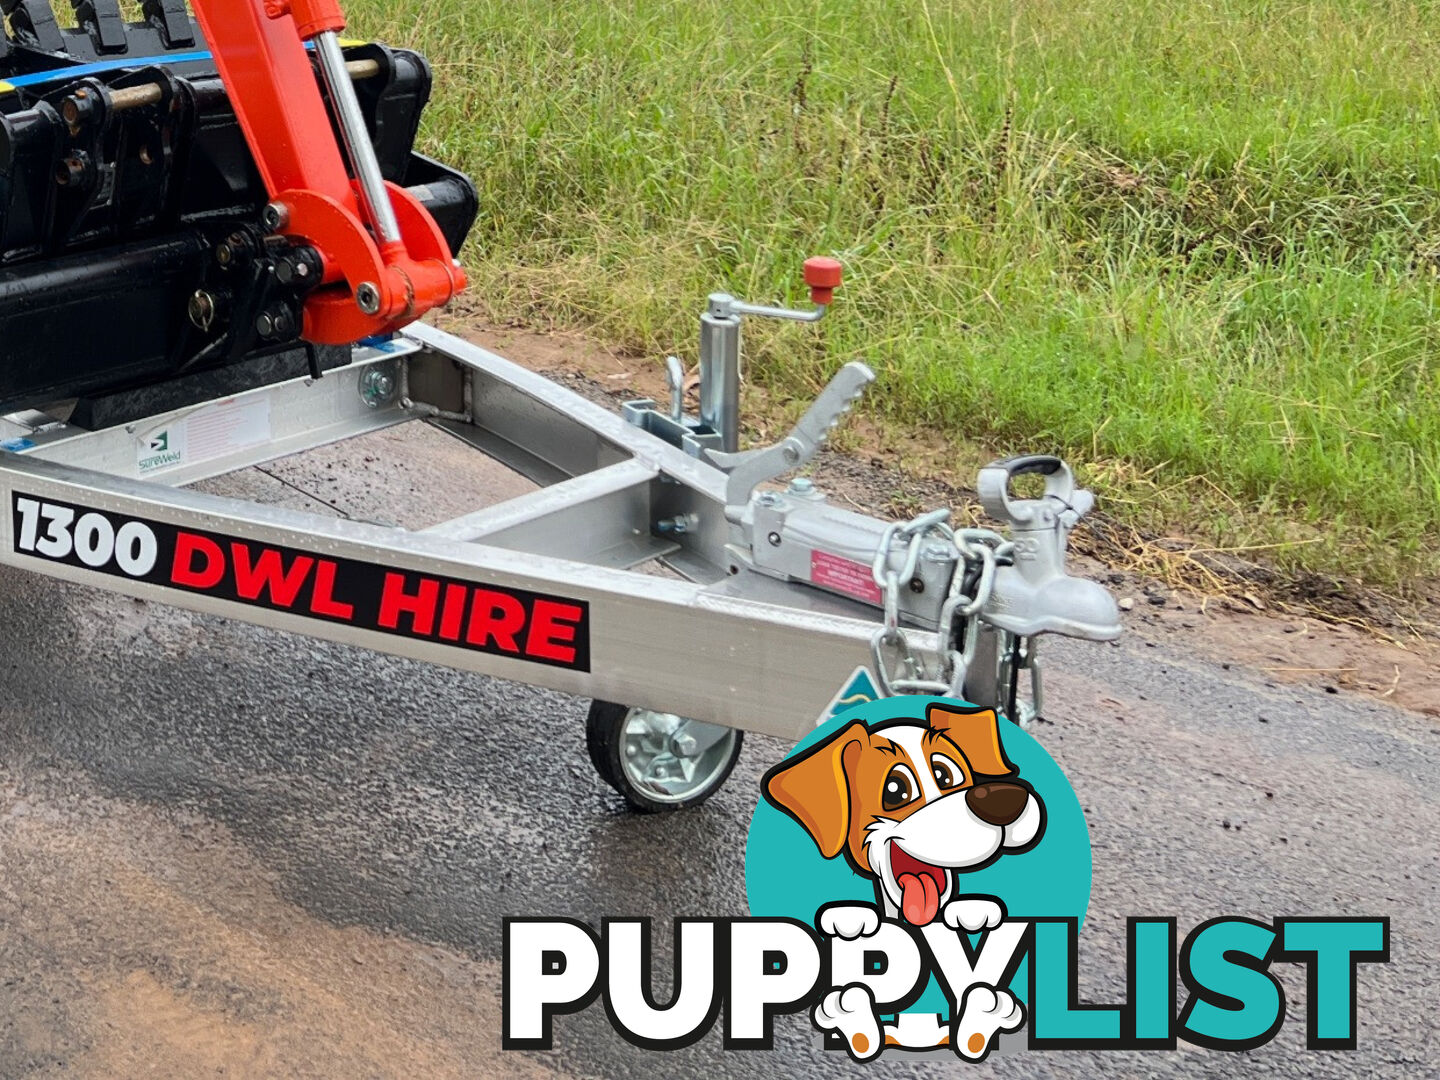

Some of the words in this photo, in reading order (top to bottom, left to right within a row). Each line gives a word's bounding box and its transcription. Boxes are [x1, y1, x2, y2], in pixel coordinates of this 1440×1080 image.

[16, 497, 158, 576] 1300
[170, 531, 354, 619] DWL
[376, 572, 583, 663] HIRE
